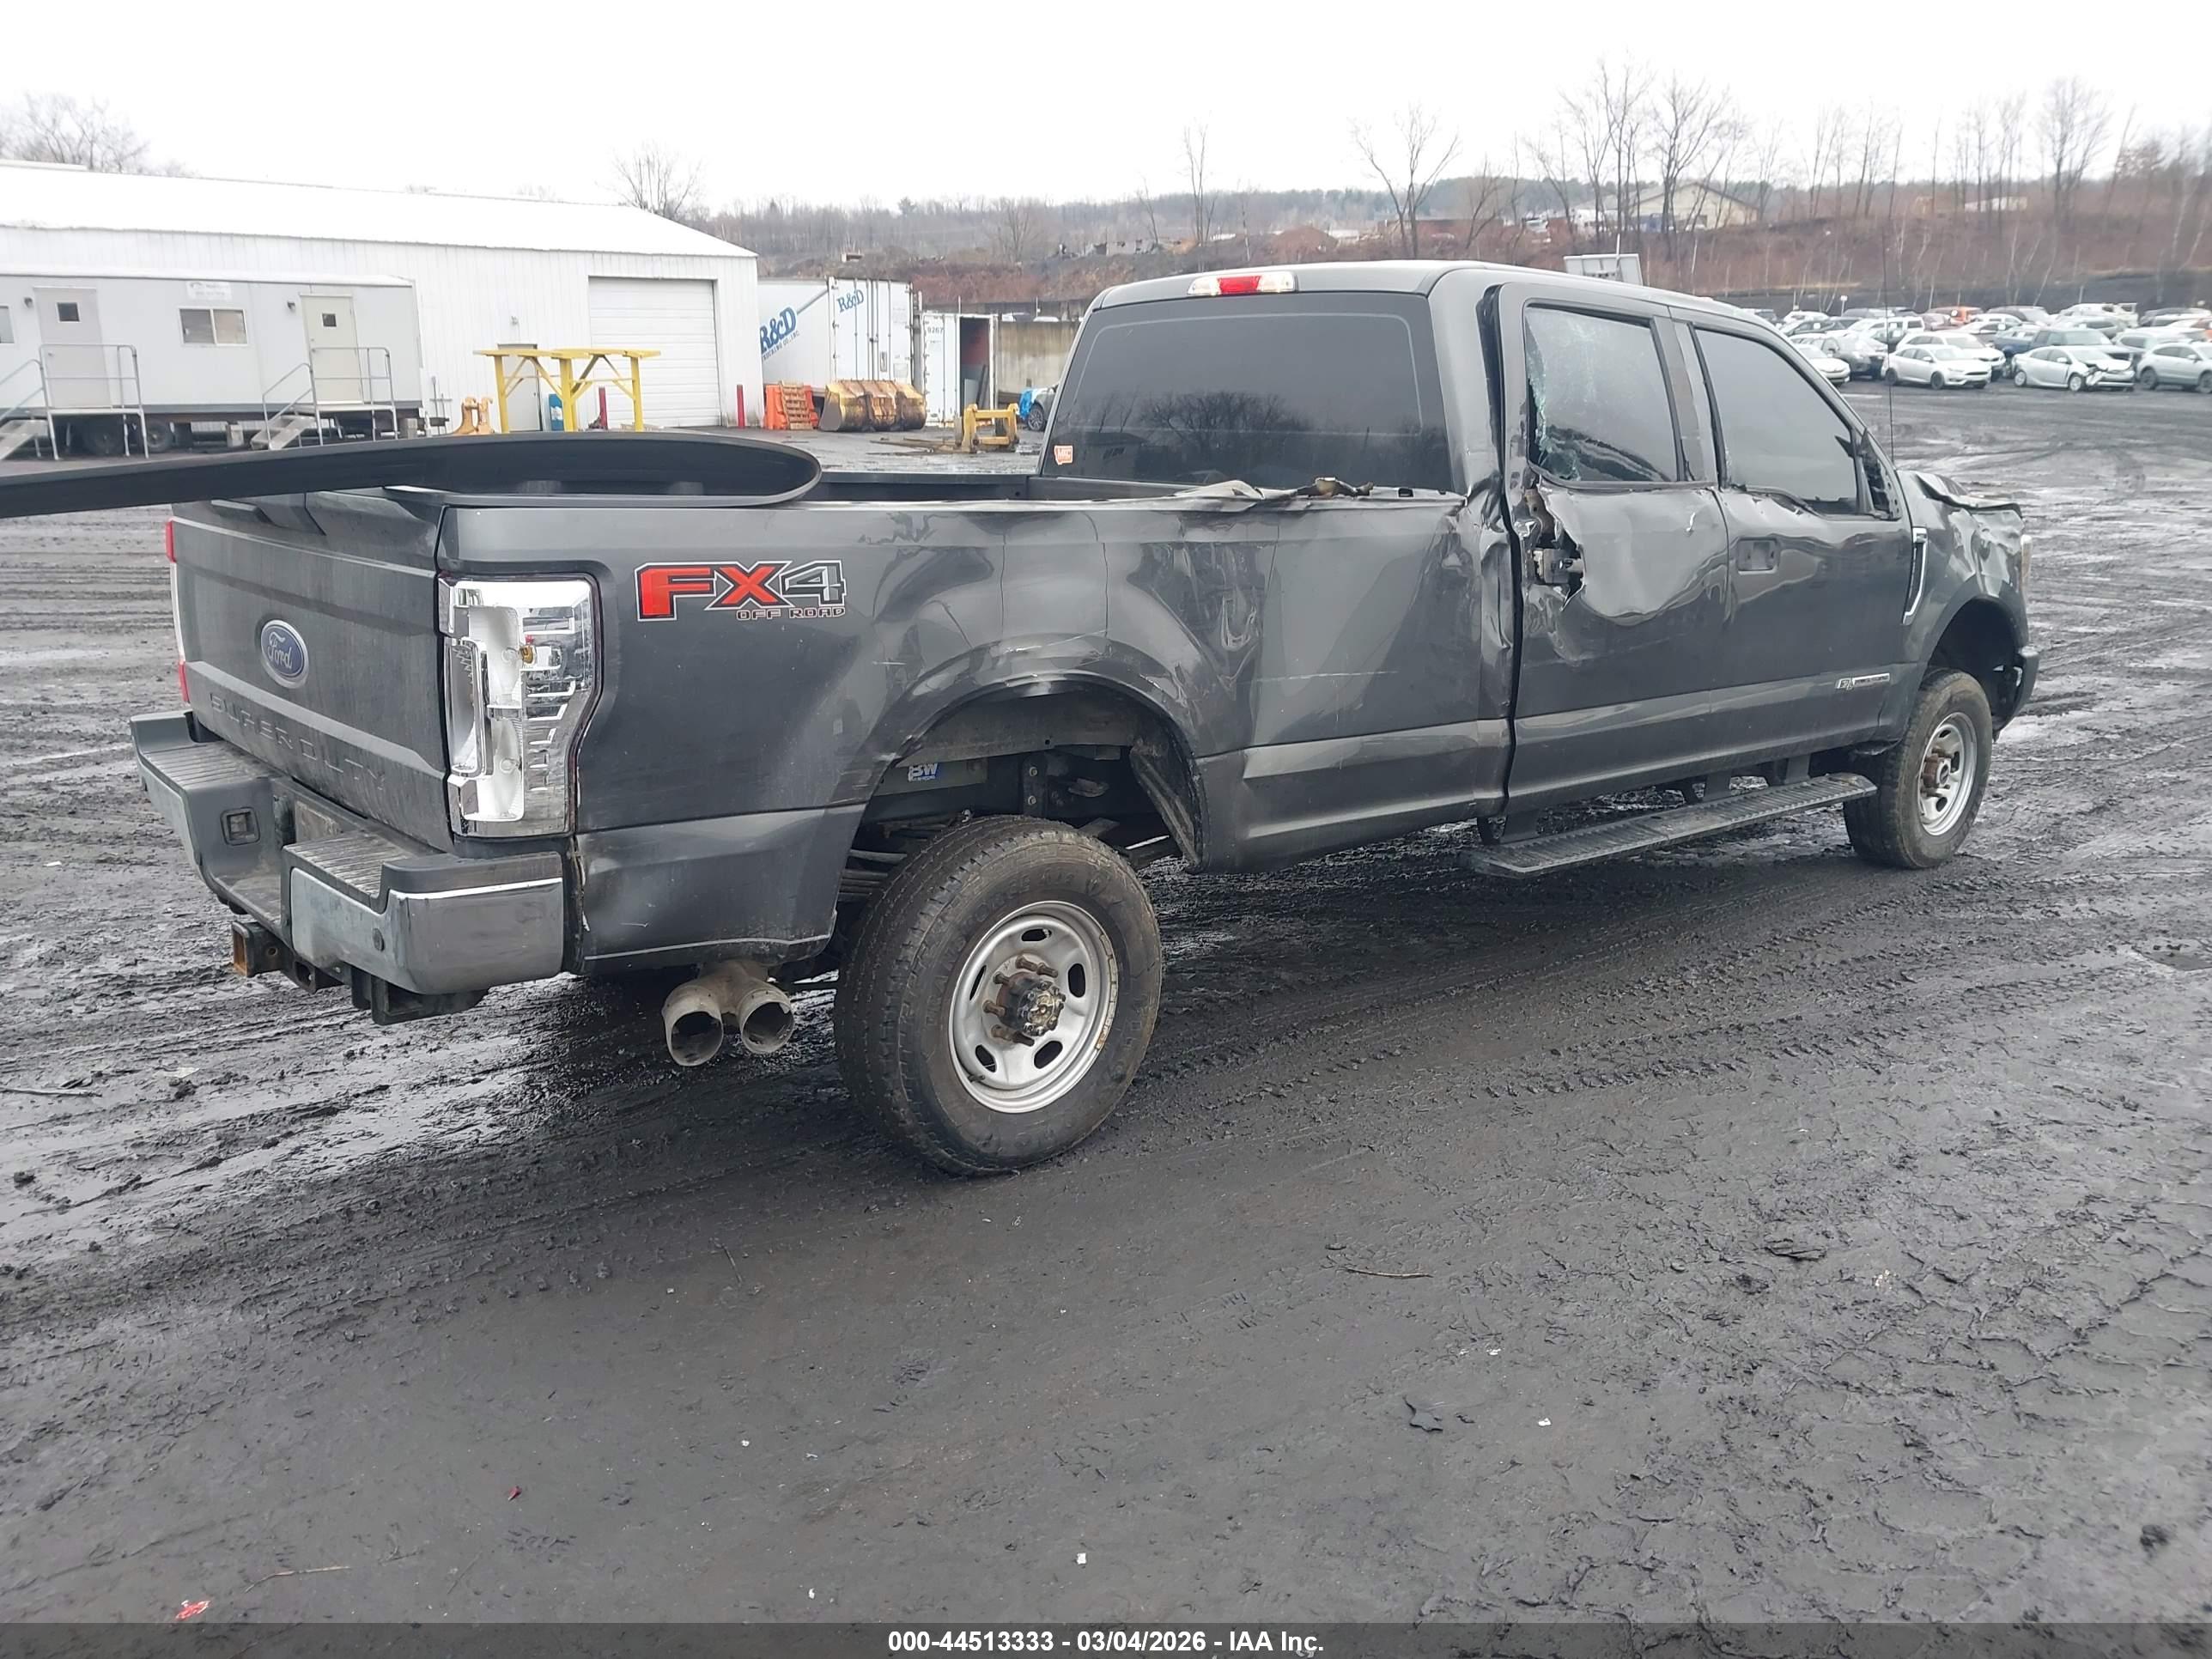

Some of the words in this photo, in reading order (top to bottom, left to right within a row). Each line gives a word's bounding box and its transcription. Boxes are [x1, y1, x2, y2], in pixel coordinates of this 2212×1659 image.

[836, 289, 864, 313] R&D
[635, 560, 848, 622] FX4
[737, 609, 782, 621] OFF
[788, 606, 847, 619] ROAD
[267, 631, 293, 670] Ford
[210, 692, 294, 750] SUPER
[300, 738, 386, 791] DUTY
